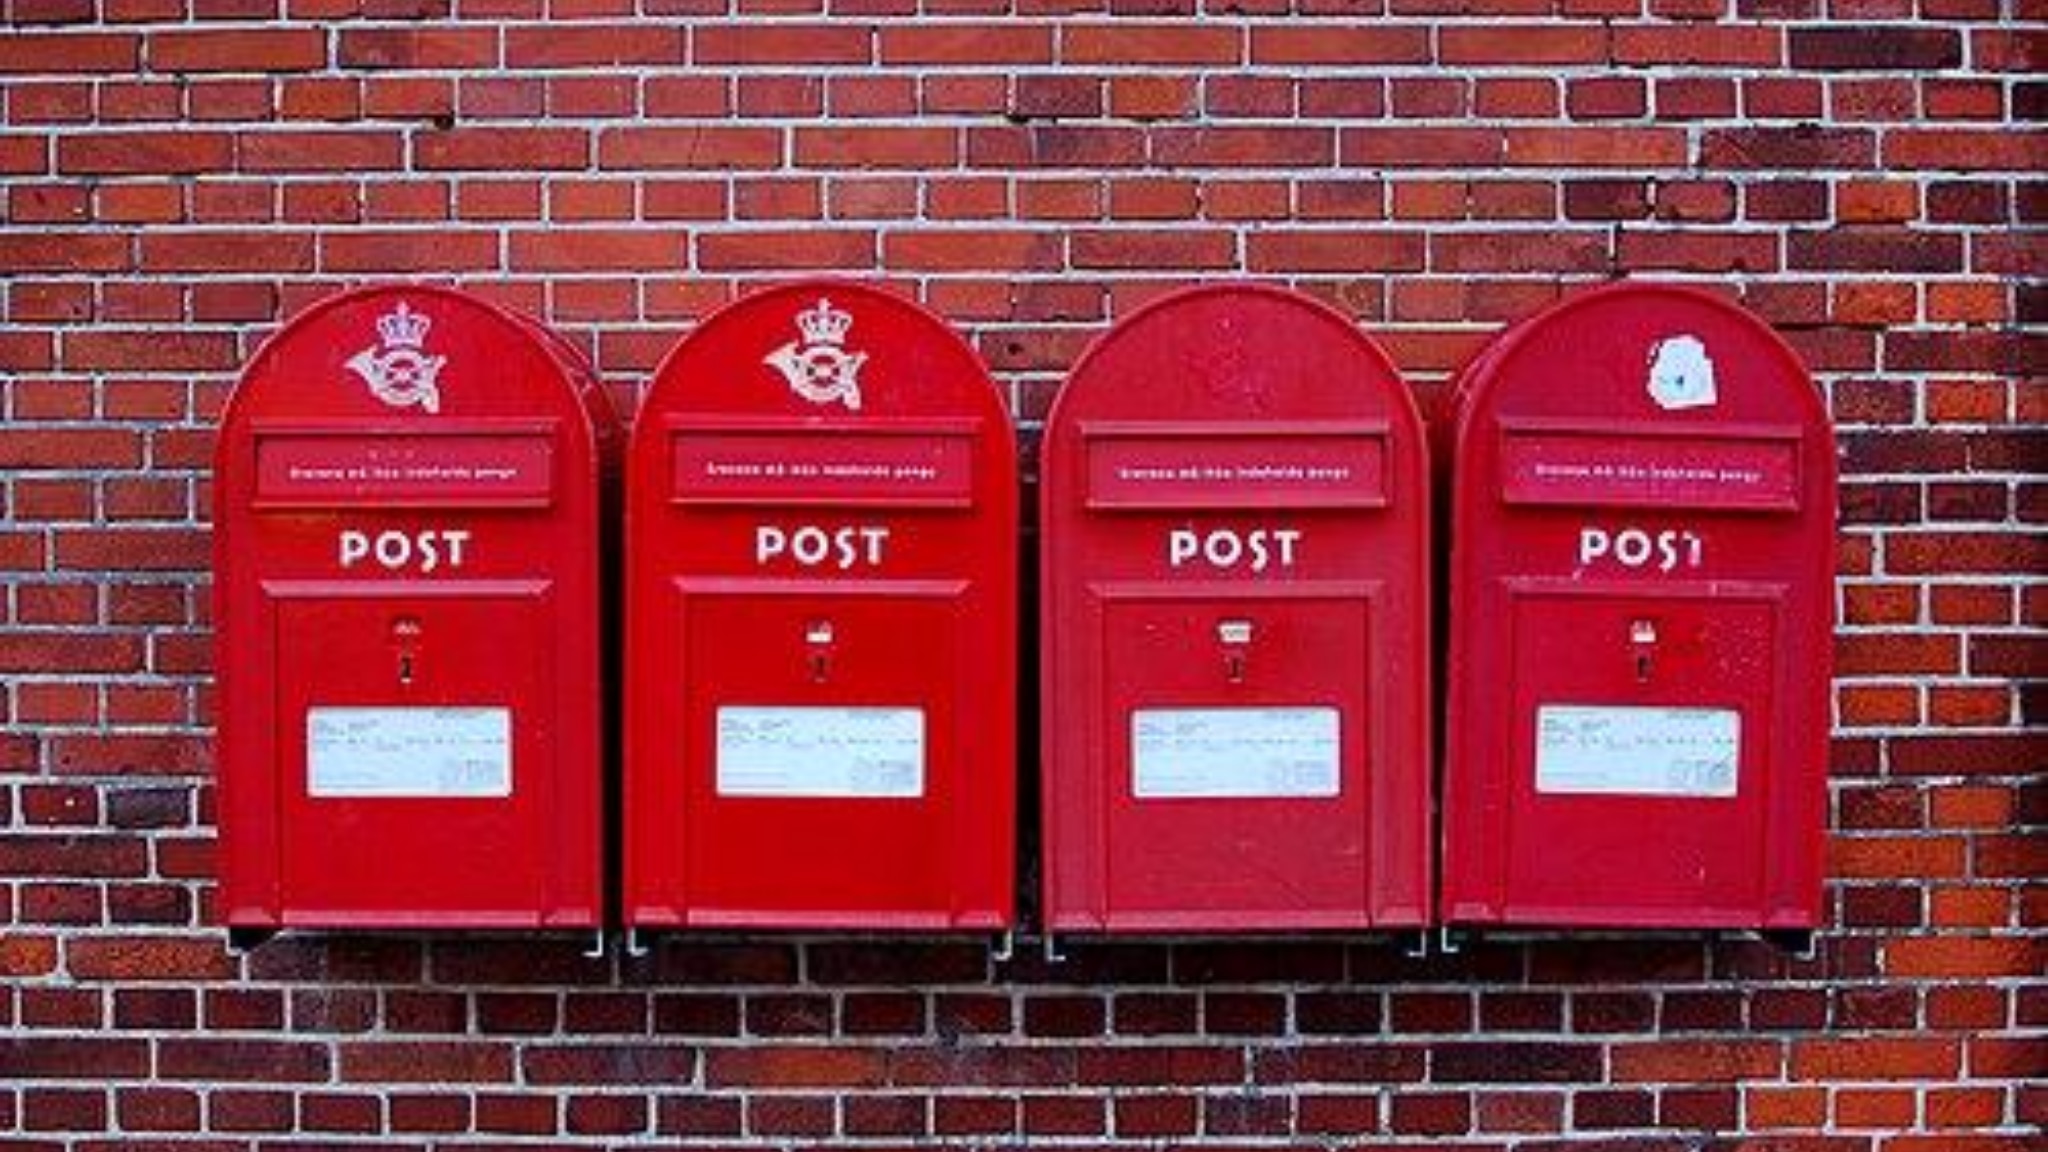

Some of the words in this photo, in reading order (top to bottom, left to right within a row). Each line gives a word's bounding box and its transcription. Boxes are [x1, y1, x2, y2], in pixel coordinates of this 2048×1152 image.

[340, 530, 470, 572] POST
[756, 526, 889, 569] POST
[1170, 530, 1300, 572] POST
